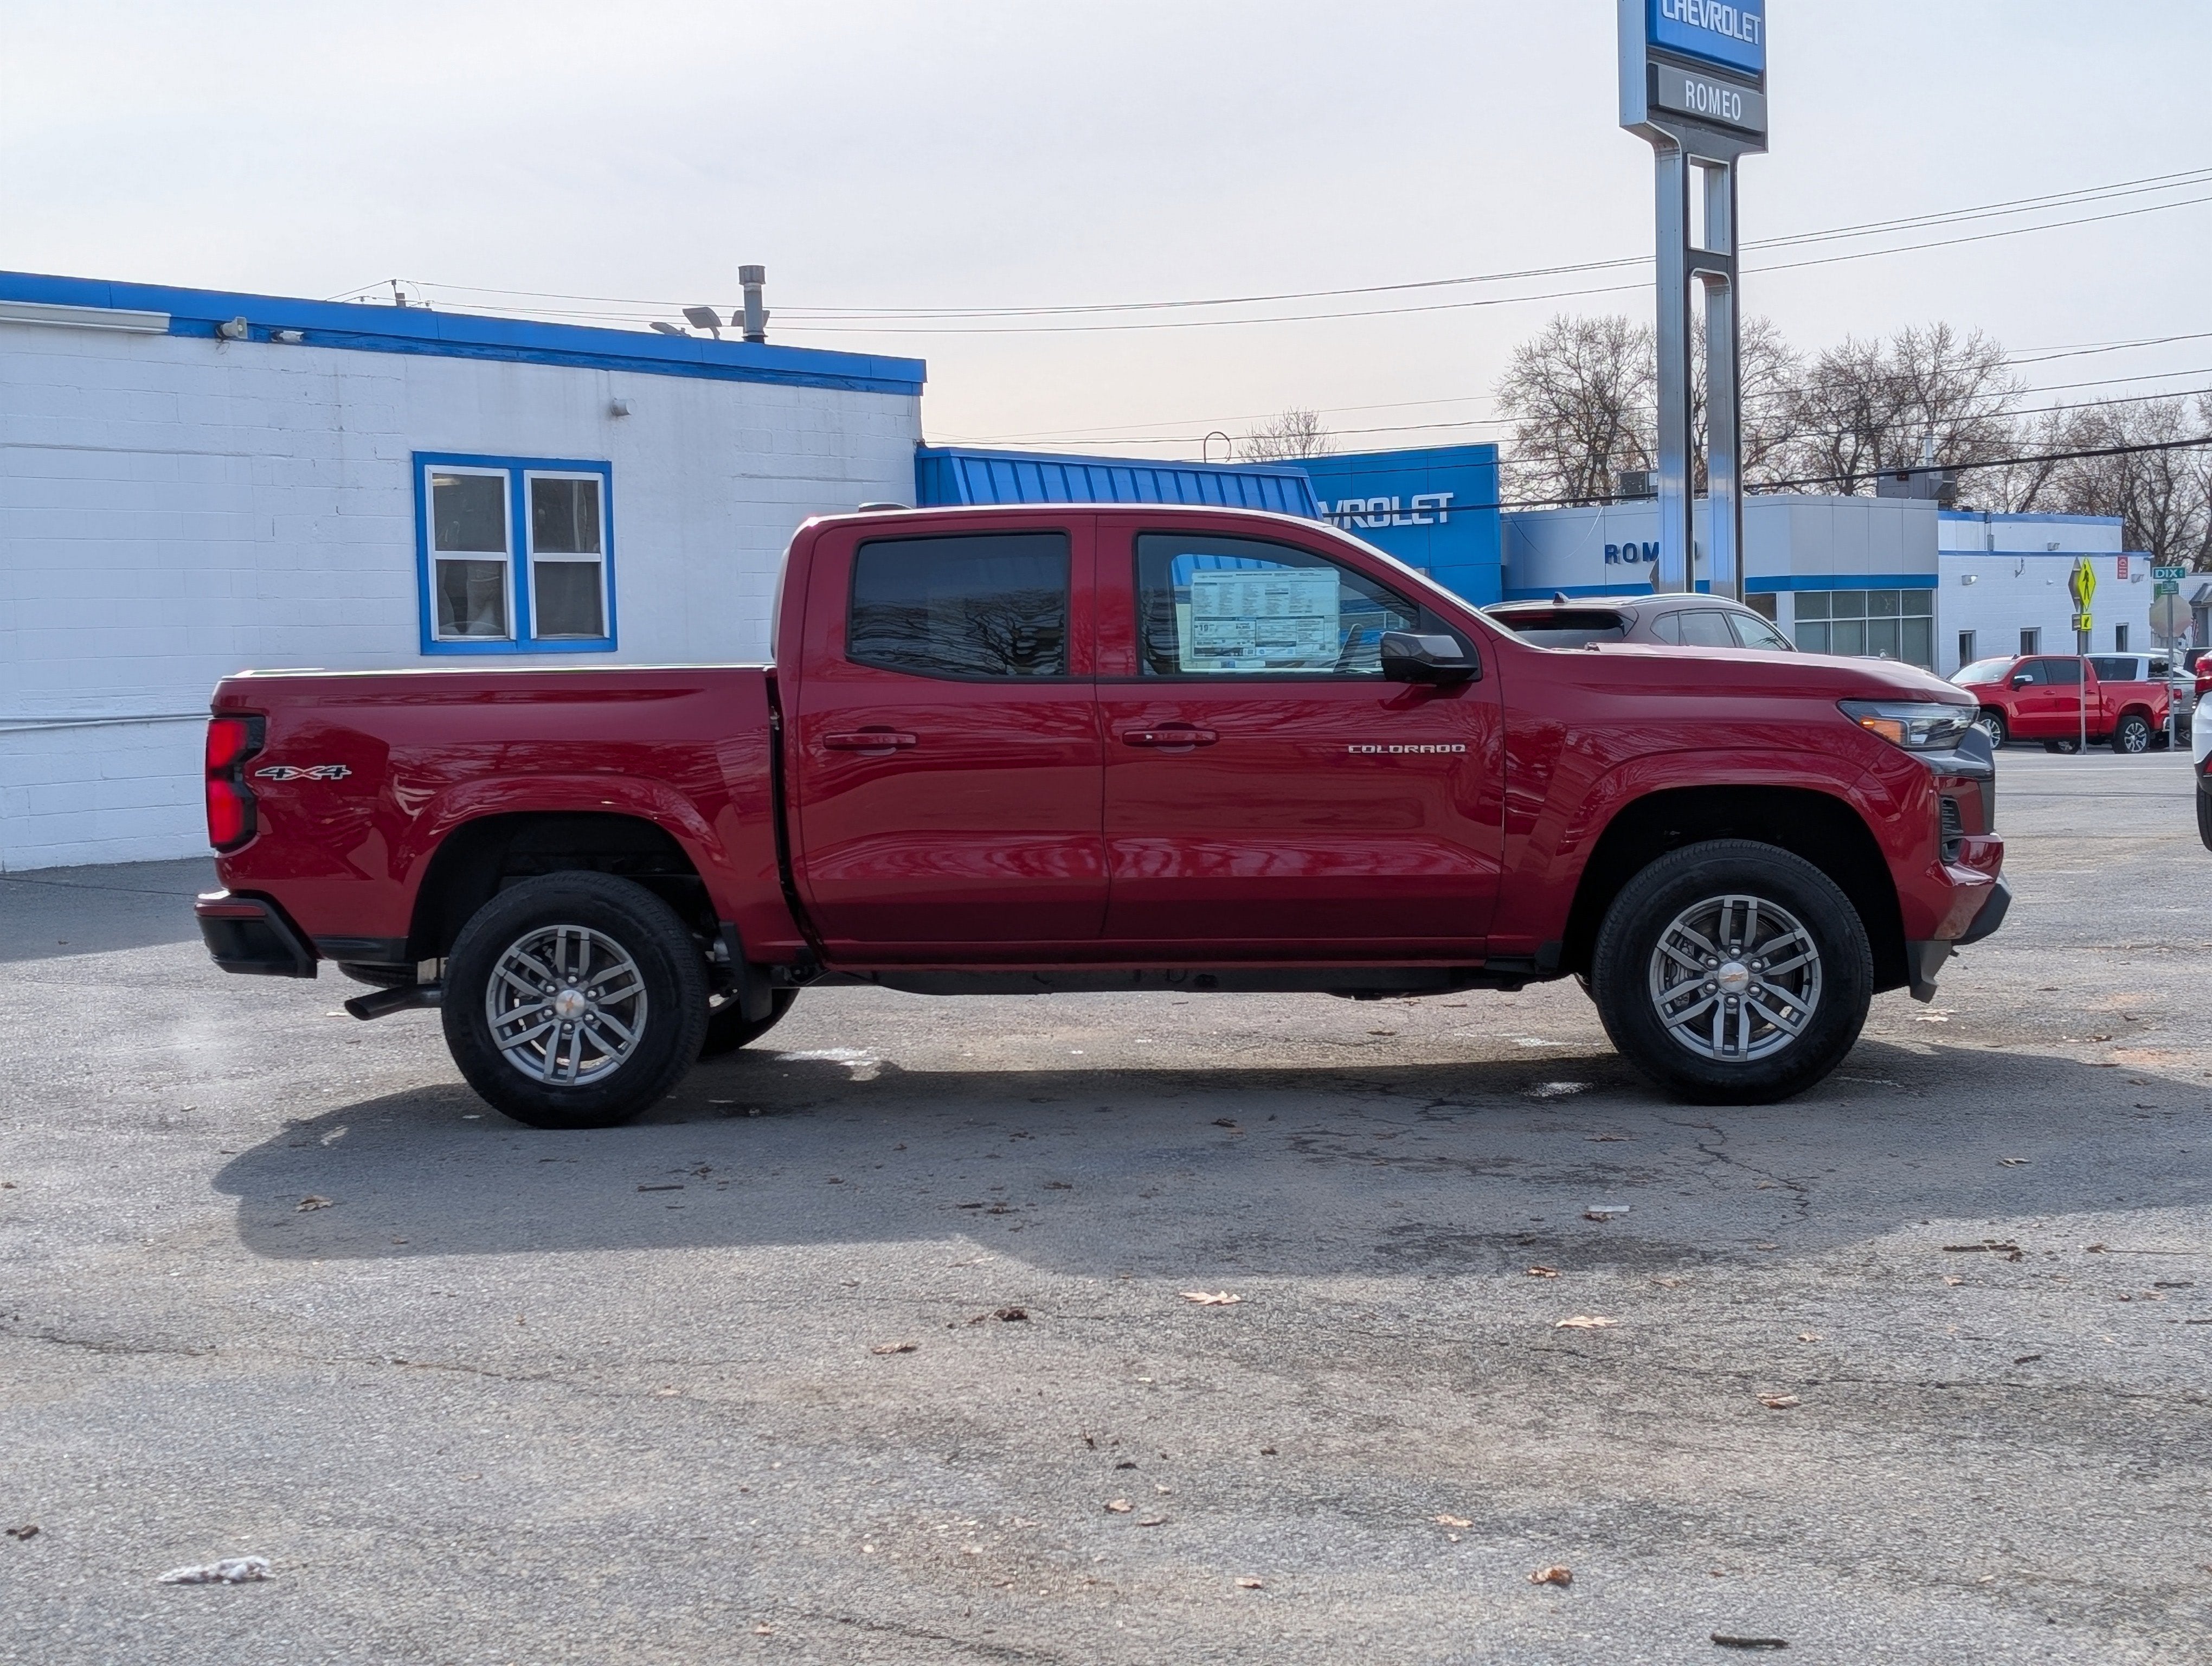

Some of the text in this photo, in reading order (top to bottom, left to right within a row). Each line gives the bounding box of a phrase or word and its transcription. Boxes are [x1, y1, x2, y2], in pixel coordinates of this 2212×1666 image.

[1662, 0, 1761, 44] CHEVROLET
[1685, 80, 1741, 121] ROMEO
[1605, 541, 1697, 565] ROM
[2155, 568, 2178, 578] DIX
[1348, 744, 1466, 754] COLORADO
